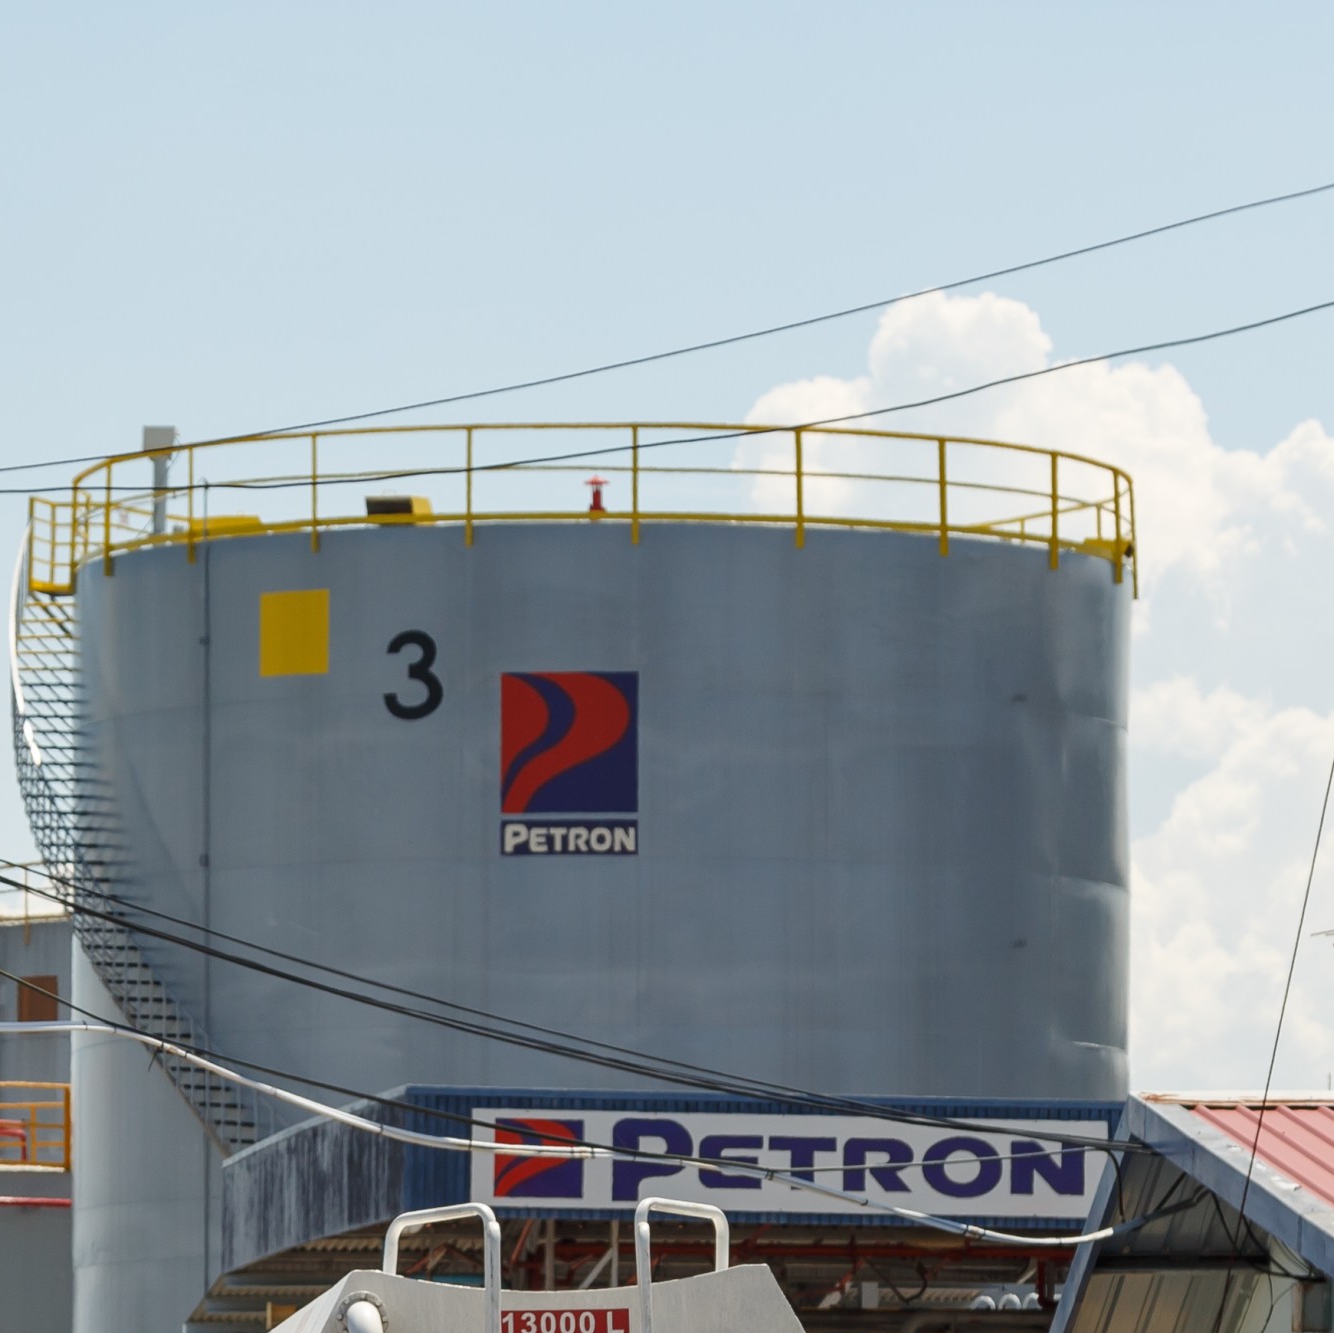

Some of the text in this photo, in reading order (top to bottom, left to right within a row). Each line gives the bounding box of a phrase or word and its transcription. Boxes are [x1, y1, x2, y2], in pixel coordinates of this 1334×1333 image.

[382, 629, 444, 720] 3
[503, 822, 637, 853] PETRON
[610, 1117, 1085, 1201] PETRON
